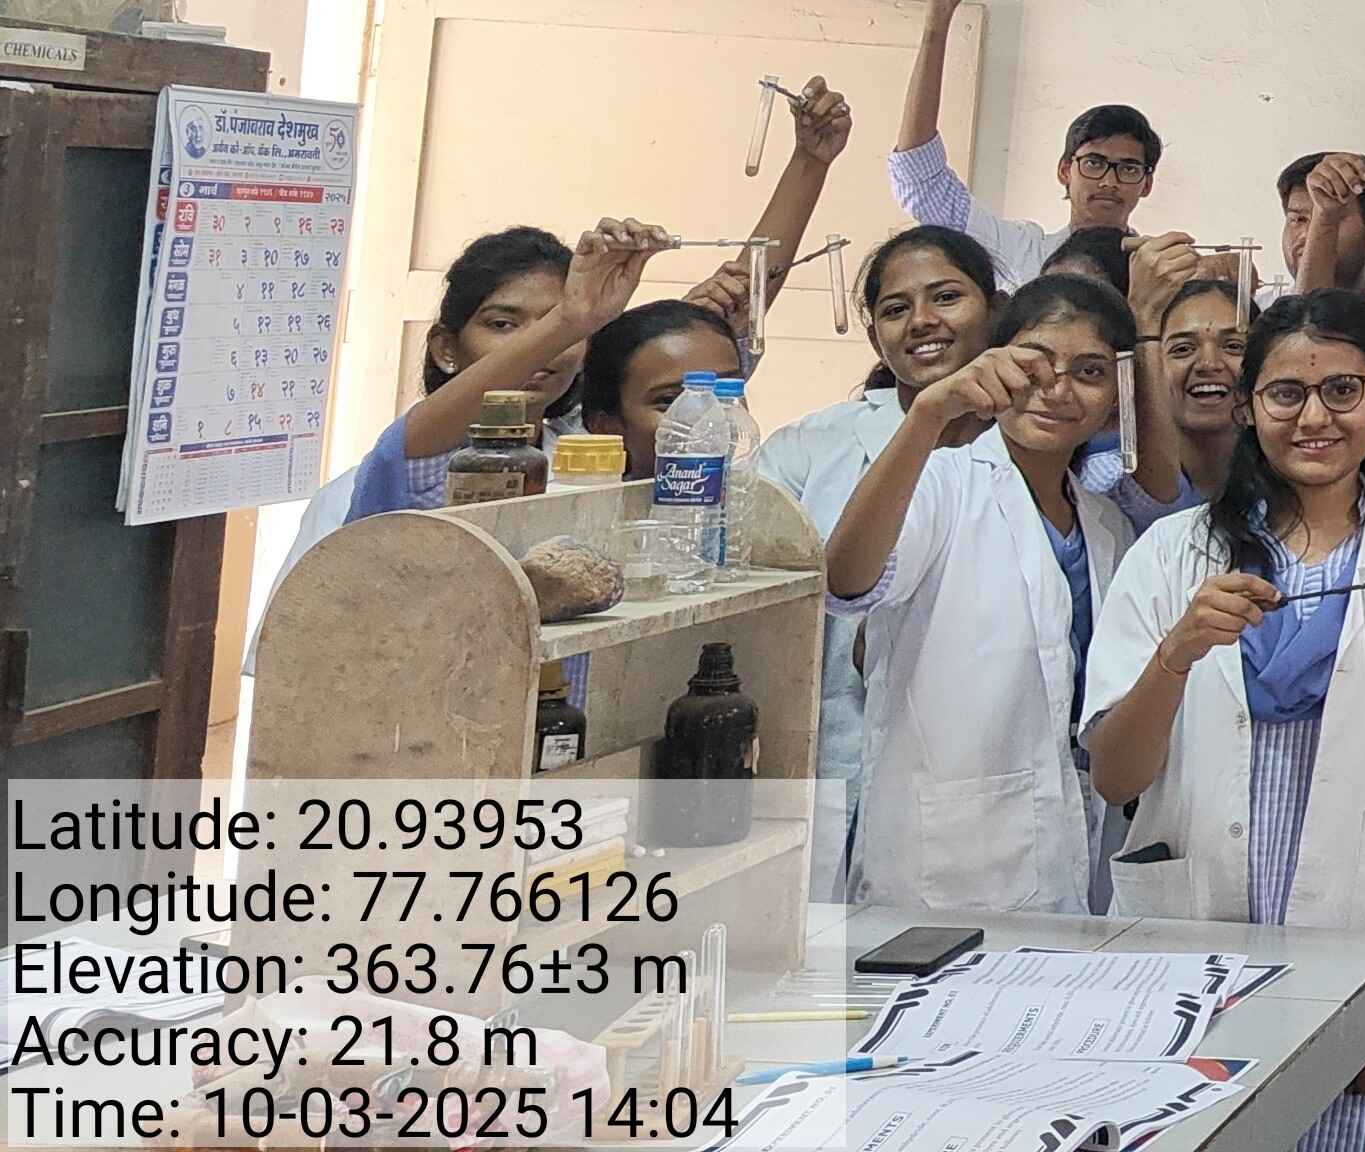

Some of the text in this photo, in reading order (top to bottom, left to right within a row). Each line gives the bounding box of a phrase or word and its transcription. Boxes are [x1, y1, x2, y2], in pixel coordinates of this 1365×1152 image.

[4, 41, 79, 62] CHEMICALS
[657, 462, 703, 482] Anand
[658, 475, 711, 496] Sagar
